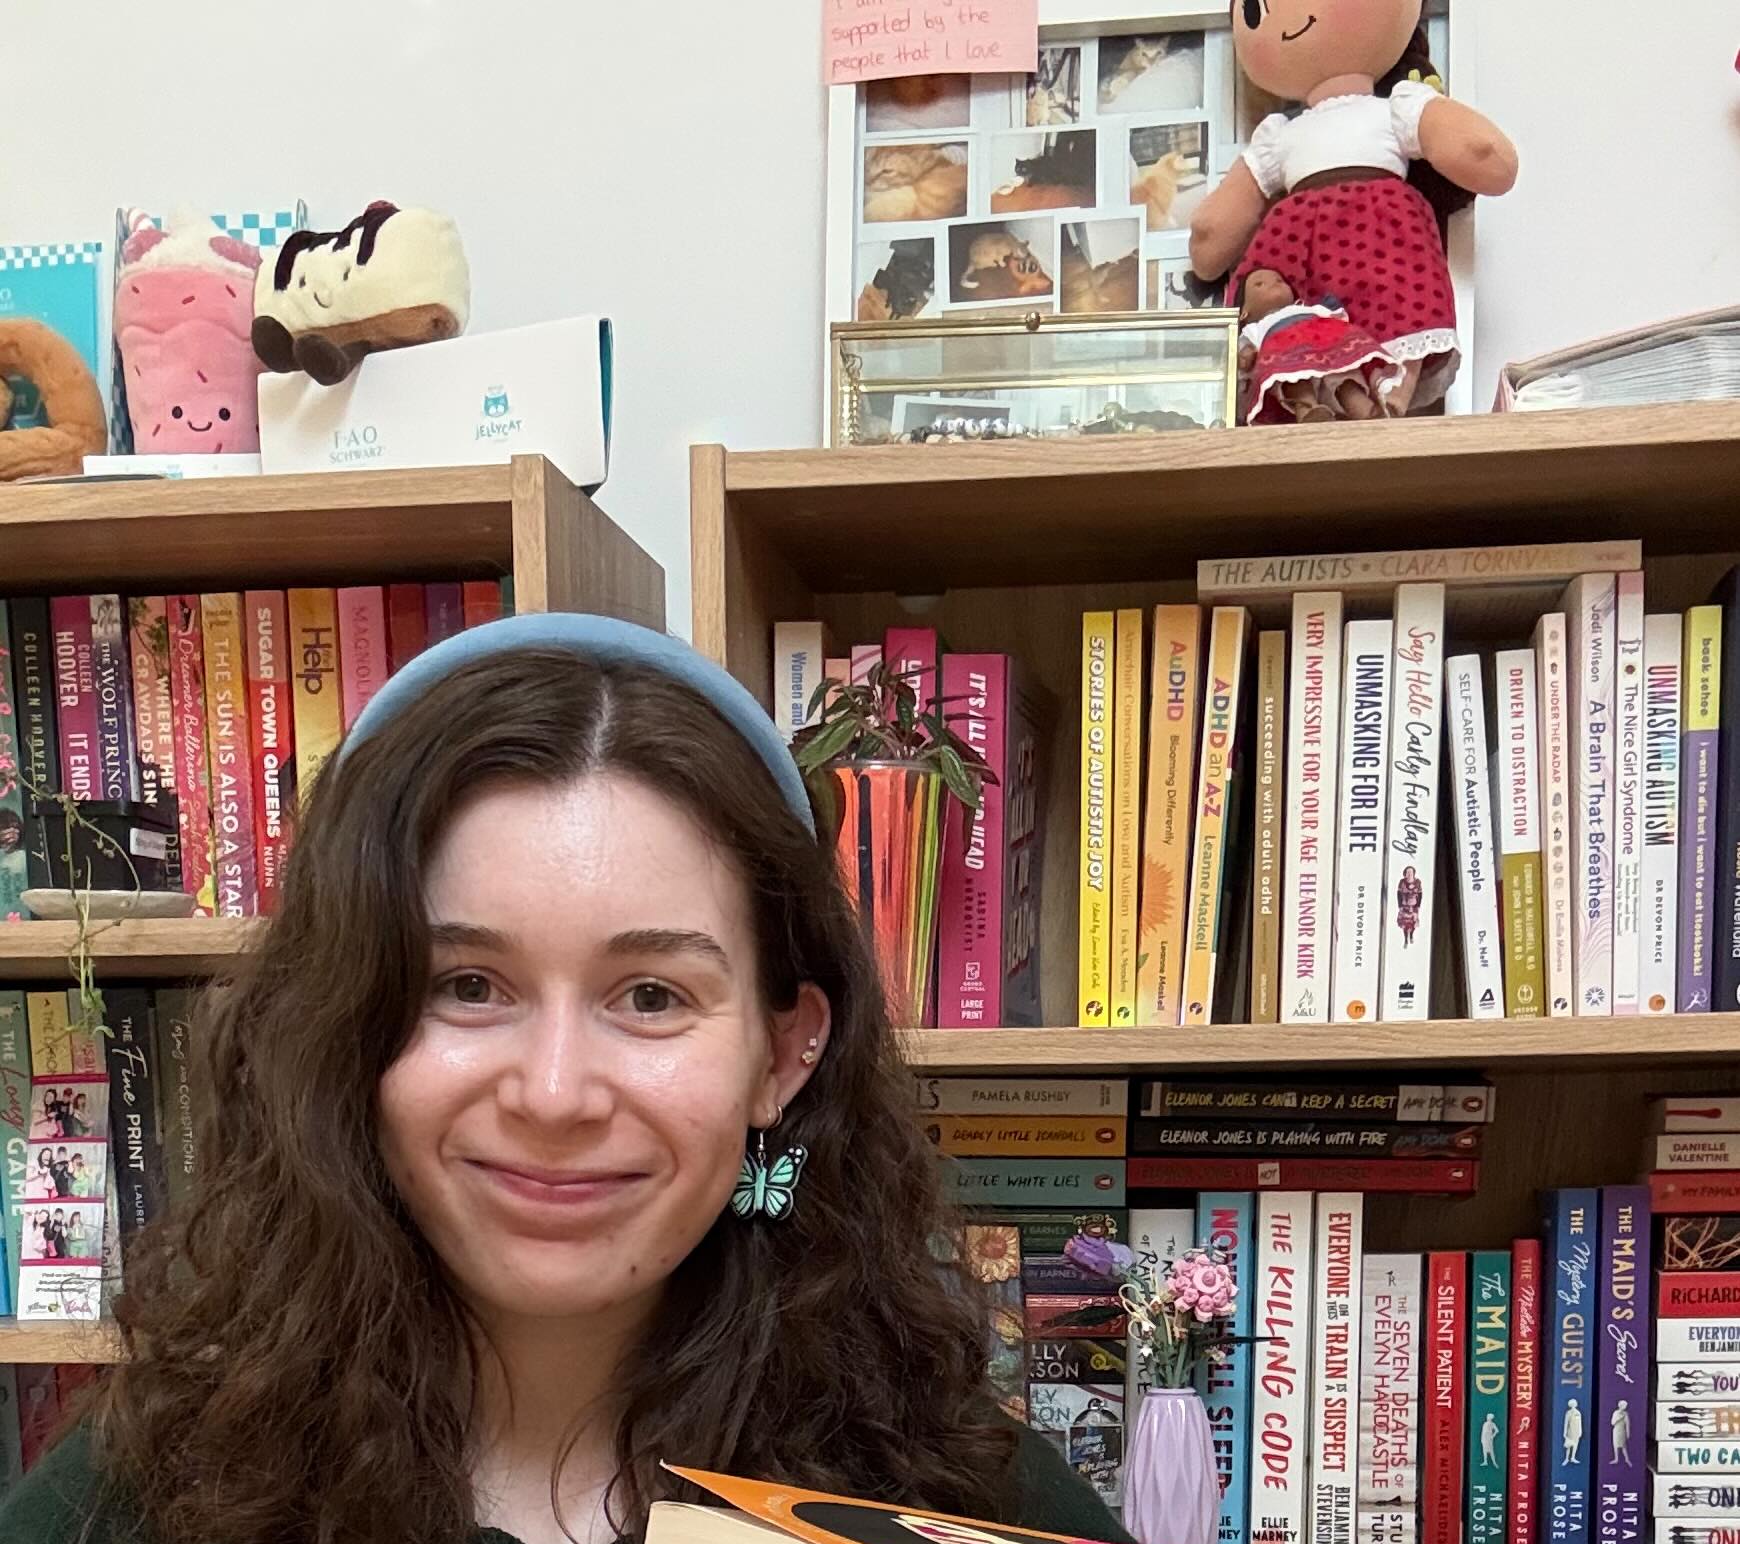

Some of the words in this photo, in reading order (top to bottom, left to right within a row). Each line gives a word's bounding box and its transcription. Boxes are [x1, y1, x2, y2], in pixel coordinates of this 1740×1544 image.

[924, 10, 945, 32] by
[958, 6, 989, 25] the
[895, 41, 931, 64] that
[966, 39, 1002, 58] love
[474, 419, 523, 441] JELLYCAT
[328, 446, 384, 465] SCHWARZ
[1213, 563, 1253, 585] THE
[1260, 558, 1353, 581] AUTISTS
[257, 607, 274, 680] SUGAR
[1305, 611, 1325, 649] VERY
[1397, 627, 1436, 666] Say
[23, 631, 41, 707] COLLEEN
[56, 631, 78, 708] HOOVER
[213, 639, 230, 682] THE
[296, 627, 335, 695] Help
[1089, 636, 1105, 723] STORIES
[1166, 640, 1187, 722] AuDHD
[215, 691, 235, 738] SUN
[260, 685, 278, 749] TOWN
[1303, 655, 1324, 747] IMPRESSIVE
[1353, 654, 1386, 769] UNMASKING
[1405, 670, 1434, 720] Hello
[1508, 668, 1524, 719] DRIVEN
[1589, 701, 1606, 717] A
[1624, 683, 1638, 712] The
[1646, 664, 1678, 772] UNMASKING
[218, 743, 237, 766] IS
[1089, 727, 1105, 758] OF
[1260, 696, 1277, 784] succeeding
[1394, 720, 1433, 778] Carly
[1511, 724, 1525, 742] TO
[1589, 722, 1607, 774] Brain
[1624, 715, 1637, 745] Nice
[1302, 753, 1321, 783] FOR
[1624, 748, 1638, 778] Girl
[219, 773, 240, 834] ALSO
[262, 754, 283, 839] QUEENS
[1088, 760, 1105, 850] AUTISTIC
[1261, 790, 1275, 826] with
[1300, 788, 1320, 830] YOUR
[1350, 774, 1380, 809] FOR
[1511, 746, 1528, 837] DISTRACTION
[1588, 778, 1606, 827] That
[1645, 779, 1676, 848] AUTISM
[1348, 815, 1379, 853] LIFE
[1391, 782, 1430, 859] Findlay
[1620, 780, 1638, 856] Syndrome
[223, 839, 241, 858] A
[1087, 850, 1104, 893] JOY
[1261, 829, 1274, 872] adult
[1299, 834, 1319, 863] AGE
[224, 864, 246, 919] STAR
[1259, 876, 1273, 915] adhd
[1587, 831, 1606, 920] Breathes
[1297, 873, 1317, 938] ELEANOR
[1296, 943, 1315, 979] KIRK
[123, 1016, 134, 1042] THE
[960, 1000, 984, 1009] LARGE
[960, 1010, 984, 1021] PRINT
[112, 1045, 148, 1107] Fine
[126, 1113, 145, 1172] PRINT
[1668, 1153, 1730, 1164] VALENTINE
[1672, 1142, 1727, 1153] DANIELLE
[1007, 1175, 1046, 1188] WHITE
[1053, 1174, 1081, 1188] LIES
[1270, 1212, 1292, 1255] THE
[1570, 1207, 1584, 1236] THE
[1617, 1205, 1633, 1235] THE
[1327, 1212, 1352, 1299] EVERYONE
[1557, 1241, 1591, 1305] Mystery
[1610, 1237, 1636, 1321] MAID'S
[1396, 1295, 1407, 1315] THE
[1477, 1272, 1506, 1300] The
[1261, 1266, 1297, 1399] KILLING
[1371, 1295, 1392, 1367] EVELYN
[1435, 1285, 1455, 1345] SILENT
[1324, 1322, 1349, 1382] TRAIN
[1391, 1320, 1410, 1382] SEVEN
[1474, 1304, 1507, 1395] MAID
[1561, 1313, 1584, 1390] GUEST
[1606, 1323, 1638, 1384] Secret
[1435, 1348, 1454, 1409] PATIENT
[1262, 1412, 1294, 1492] CODE
[1322, 1397, 1348, 1473] SUSPECT
[1370, 1375, 1391, 1489] HARDCASTLE
[1389, 1392, 1410, 1468] DEATHS
[1251, 1530, 1298, 1542] MARNEY
[1261, 1516, 1289, 1529] ELLIE
[1621, 1491, 1638, 1541] NITA
